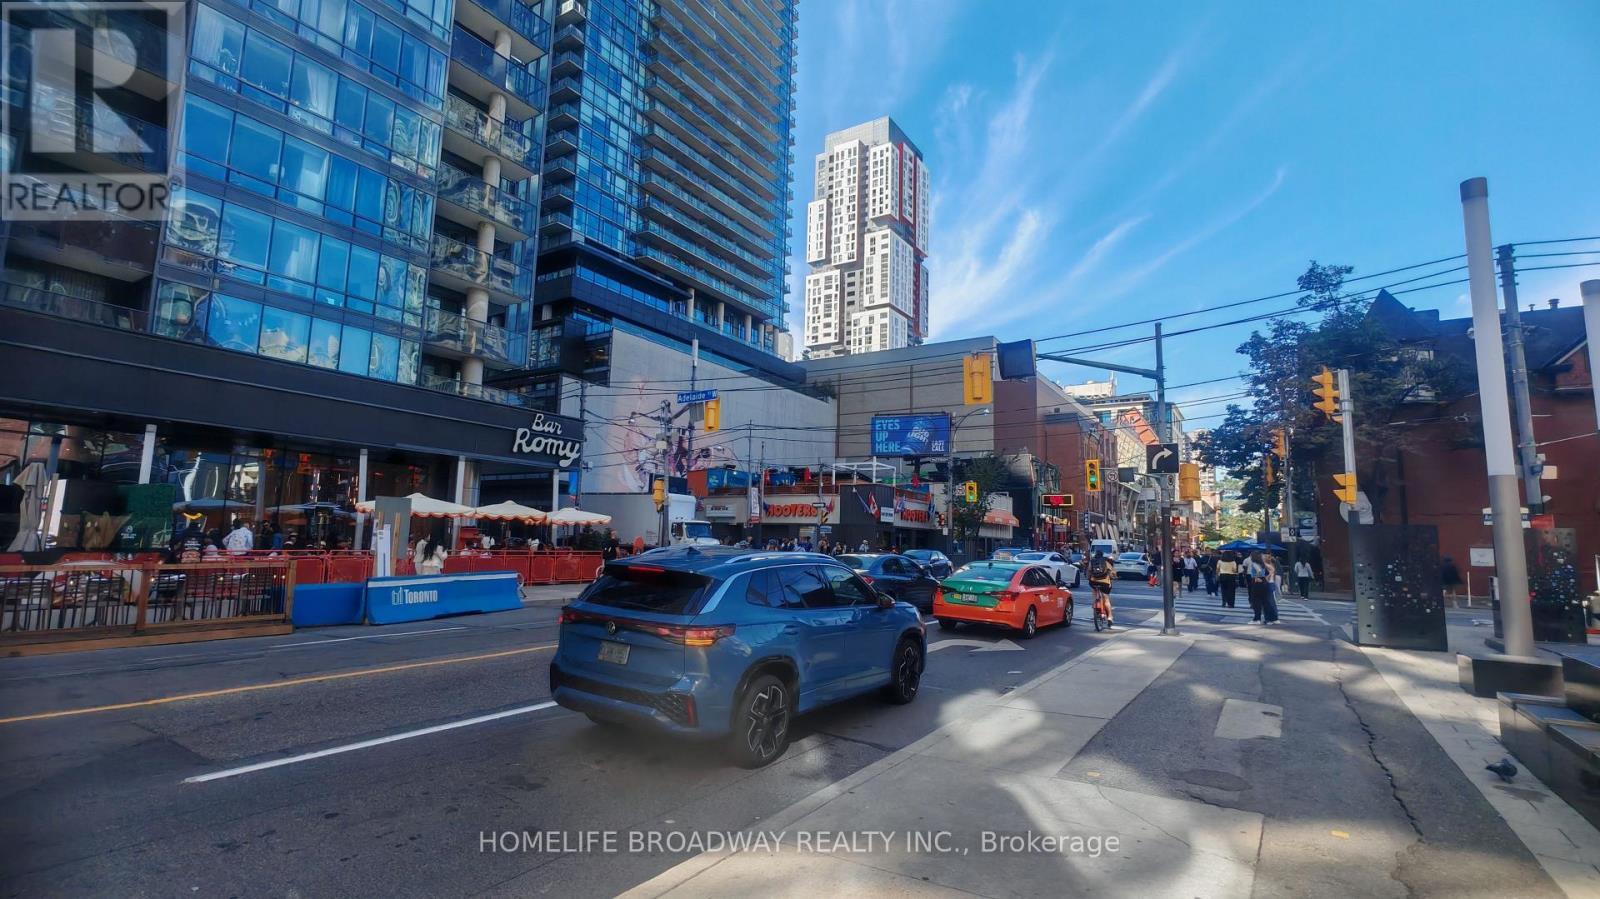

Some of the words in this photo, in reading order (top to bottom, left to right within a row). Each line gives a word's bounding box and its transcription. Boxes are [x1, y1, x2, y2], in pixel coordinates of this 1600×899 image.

[678, 393, 706, 402] Adelaide
[532, 413, 562, 435] Bar
[875, 418, 900, 430] EYES
[875, 431, 889, 442] UP
[512, 428, 580, 467] Romy
[875, 442, 901, 453] HERE
[404, 588, 438, 604] TORONTO
